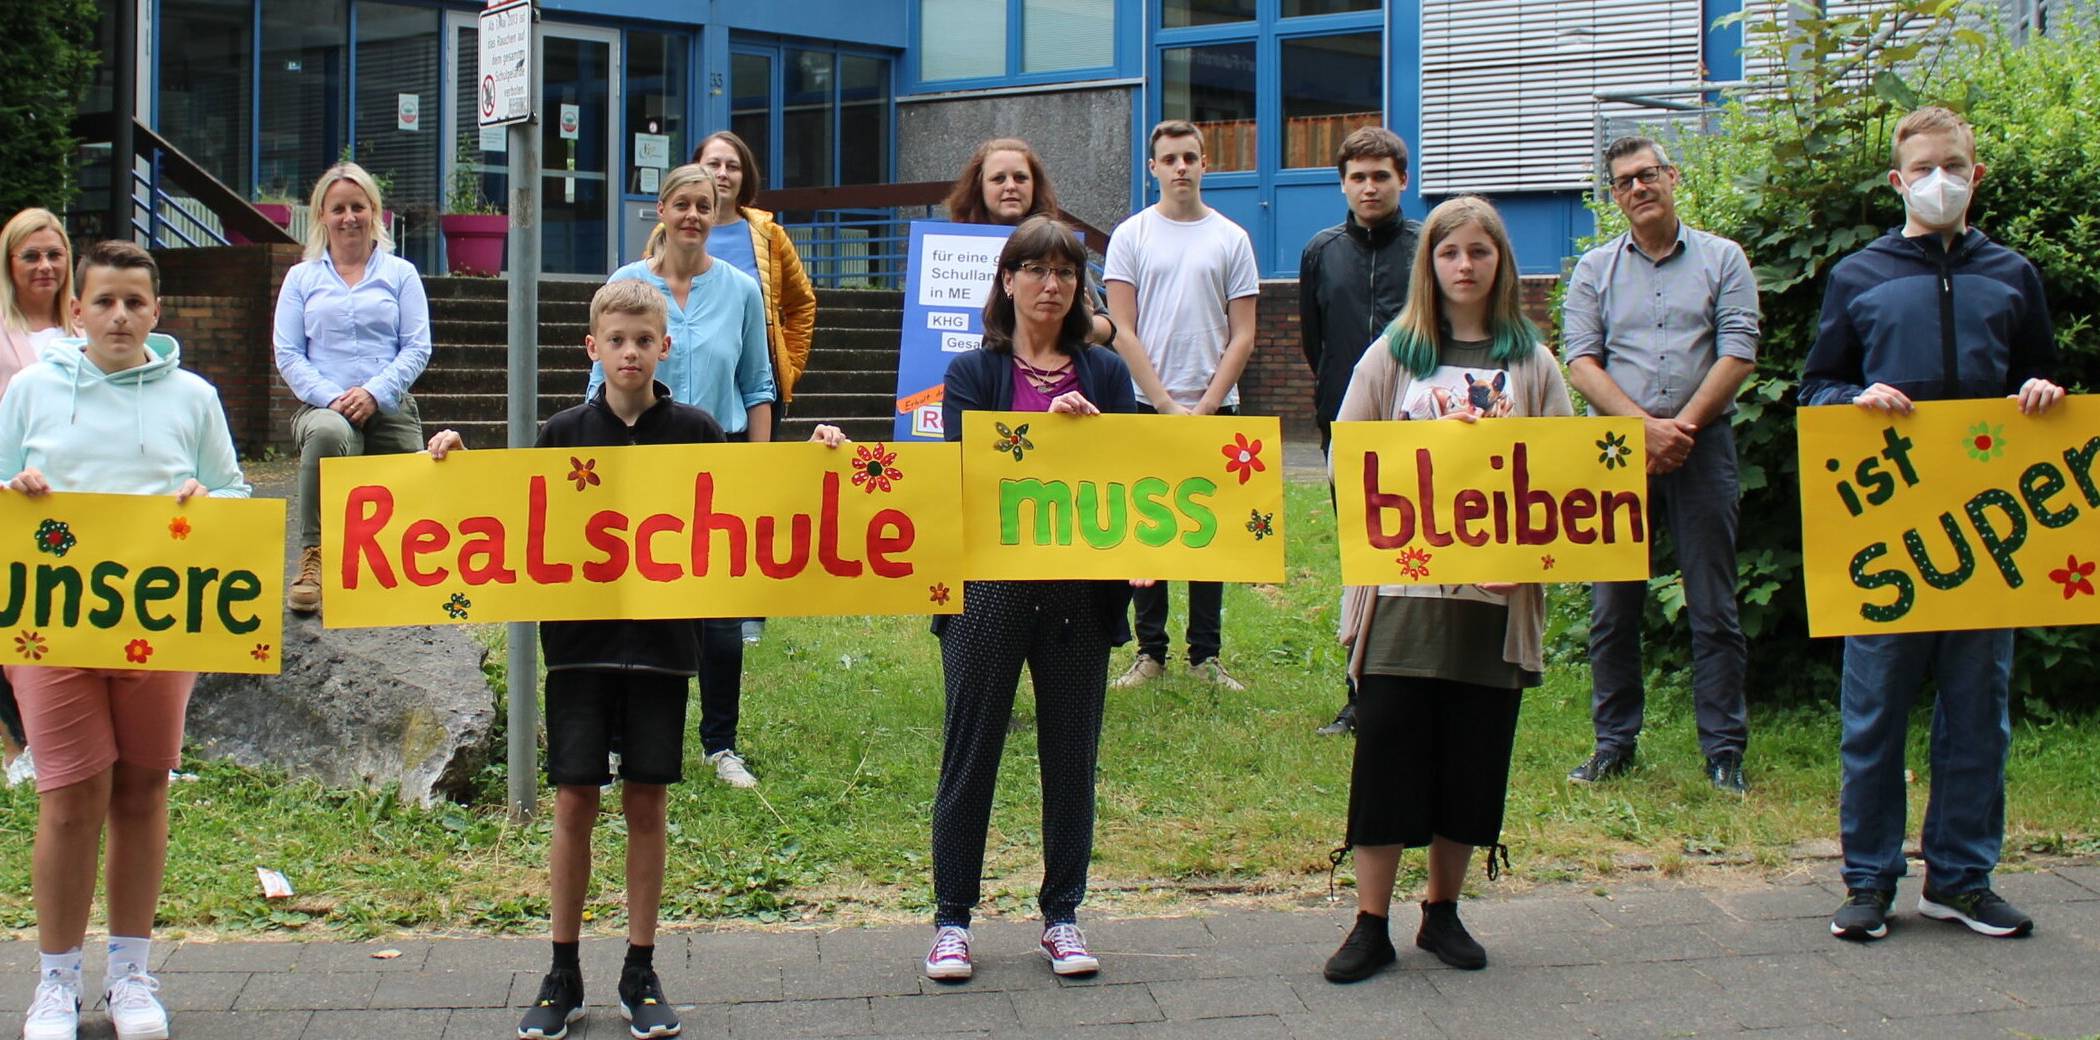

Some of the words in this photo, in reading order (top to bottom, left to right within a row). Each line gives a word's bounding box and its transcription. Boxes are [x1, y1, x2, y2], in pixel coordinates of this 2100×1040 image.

[932, 249, 953, 263] für
[957, 251, 988, 264] eine
[930, 287, 943, 298] in
[948, 288, 971, 300] ME
[932, 315, 963, 327] KHG
[1363, 442, 1645, 549] bleiben
[1825, 426, 1920, 517] ist
[341, 471, 915, 590] Realschule
[1000, 477, 1217, 549] muss
